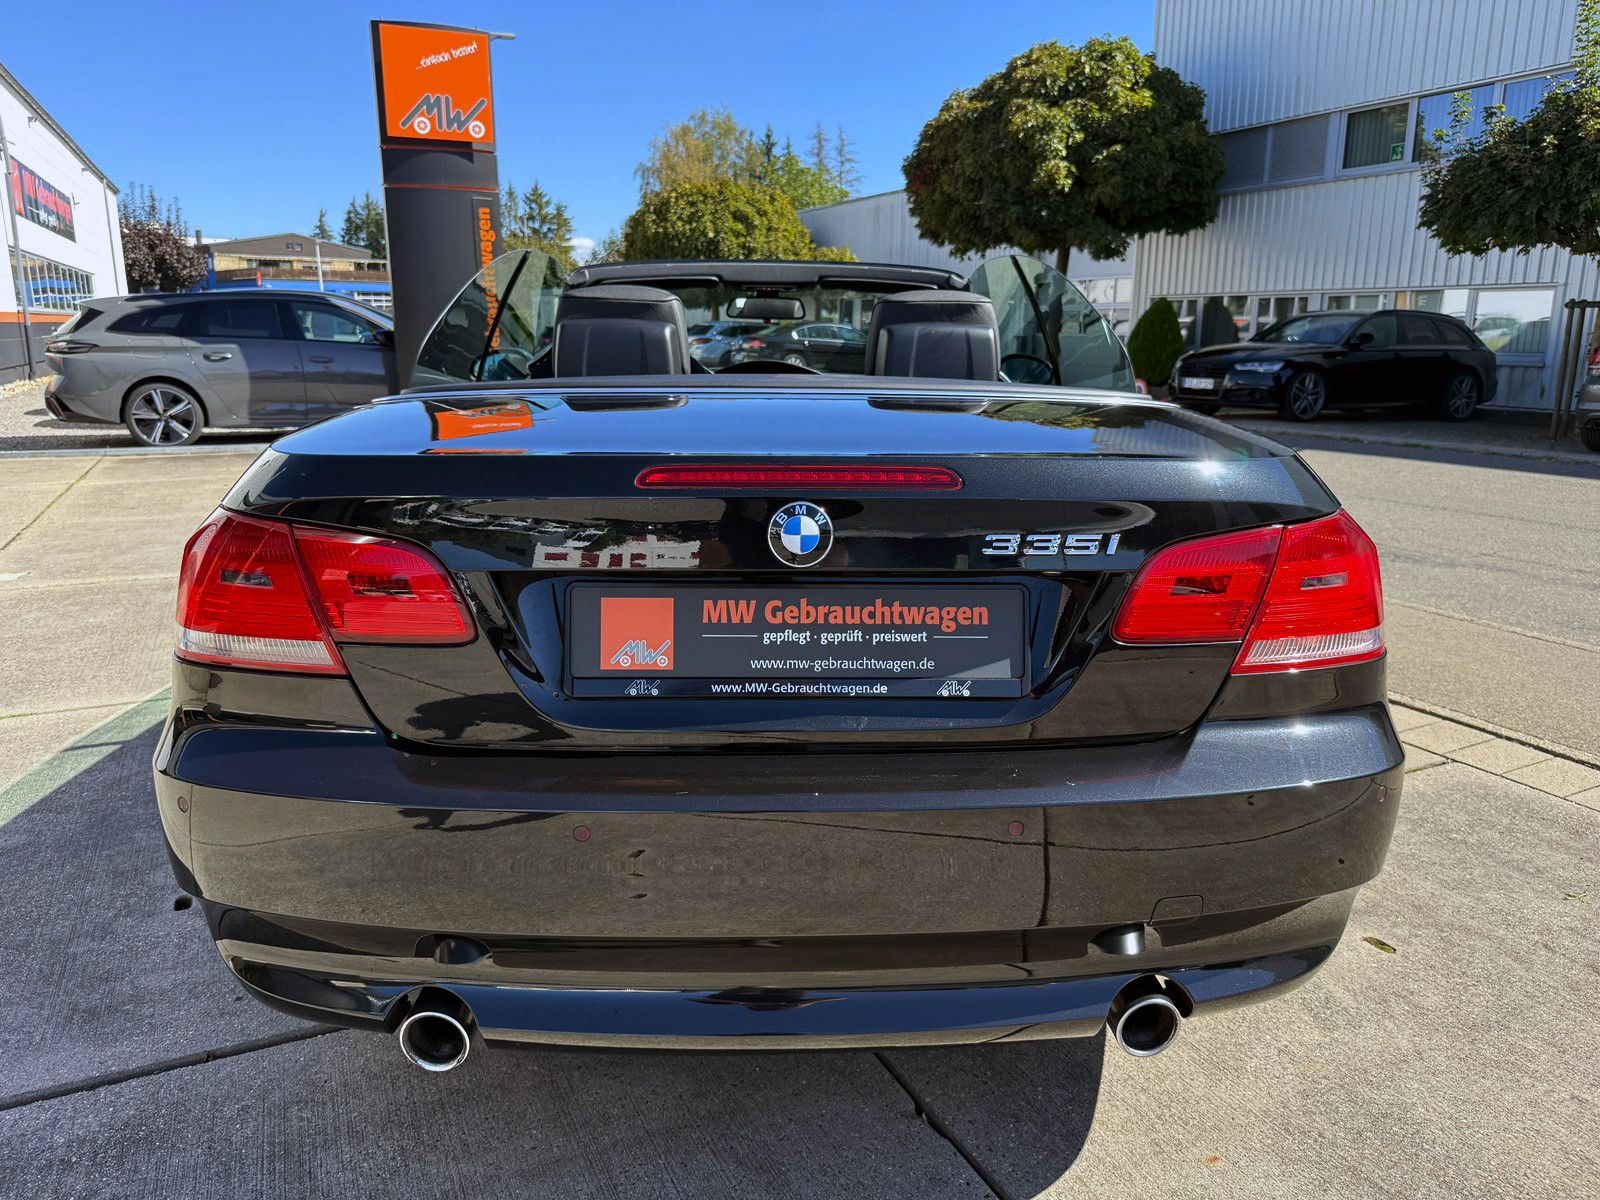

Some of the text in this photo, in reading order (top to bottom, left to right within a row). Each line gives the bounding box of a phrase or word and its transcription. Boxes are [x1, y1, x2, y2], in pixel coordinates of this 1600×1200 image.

[401, 94, 487, 138] MW
[776, 505, 826, 525] BMW
[982, 533, 1121, 555] 335i
[702, 598, 989, 633] MW Gebrauchtwagen
[763, 629, 928, 645] gepflegt geprüft preiswert
[610, 639, 671, 667] MW
[750, 657, 935, 672] www.mw-gebrauchtwagen.de
[624, 679, 661, 696] MW
[711, 682, 888, 696] www.MW-Gebrauchtwagen.de
[936, 680, 972, 697] MW
